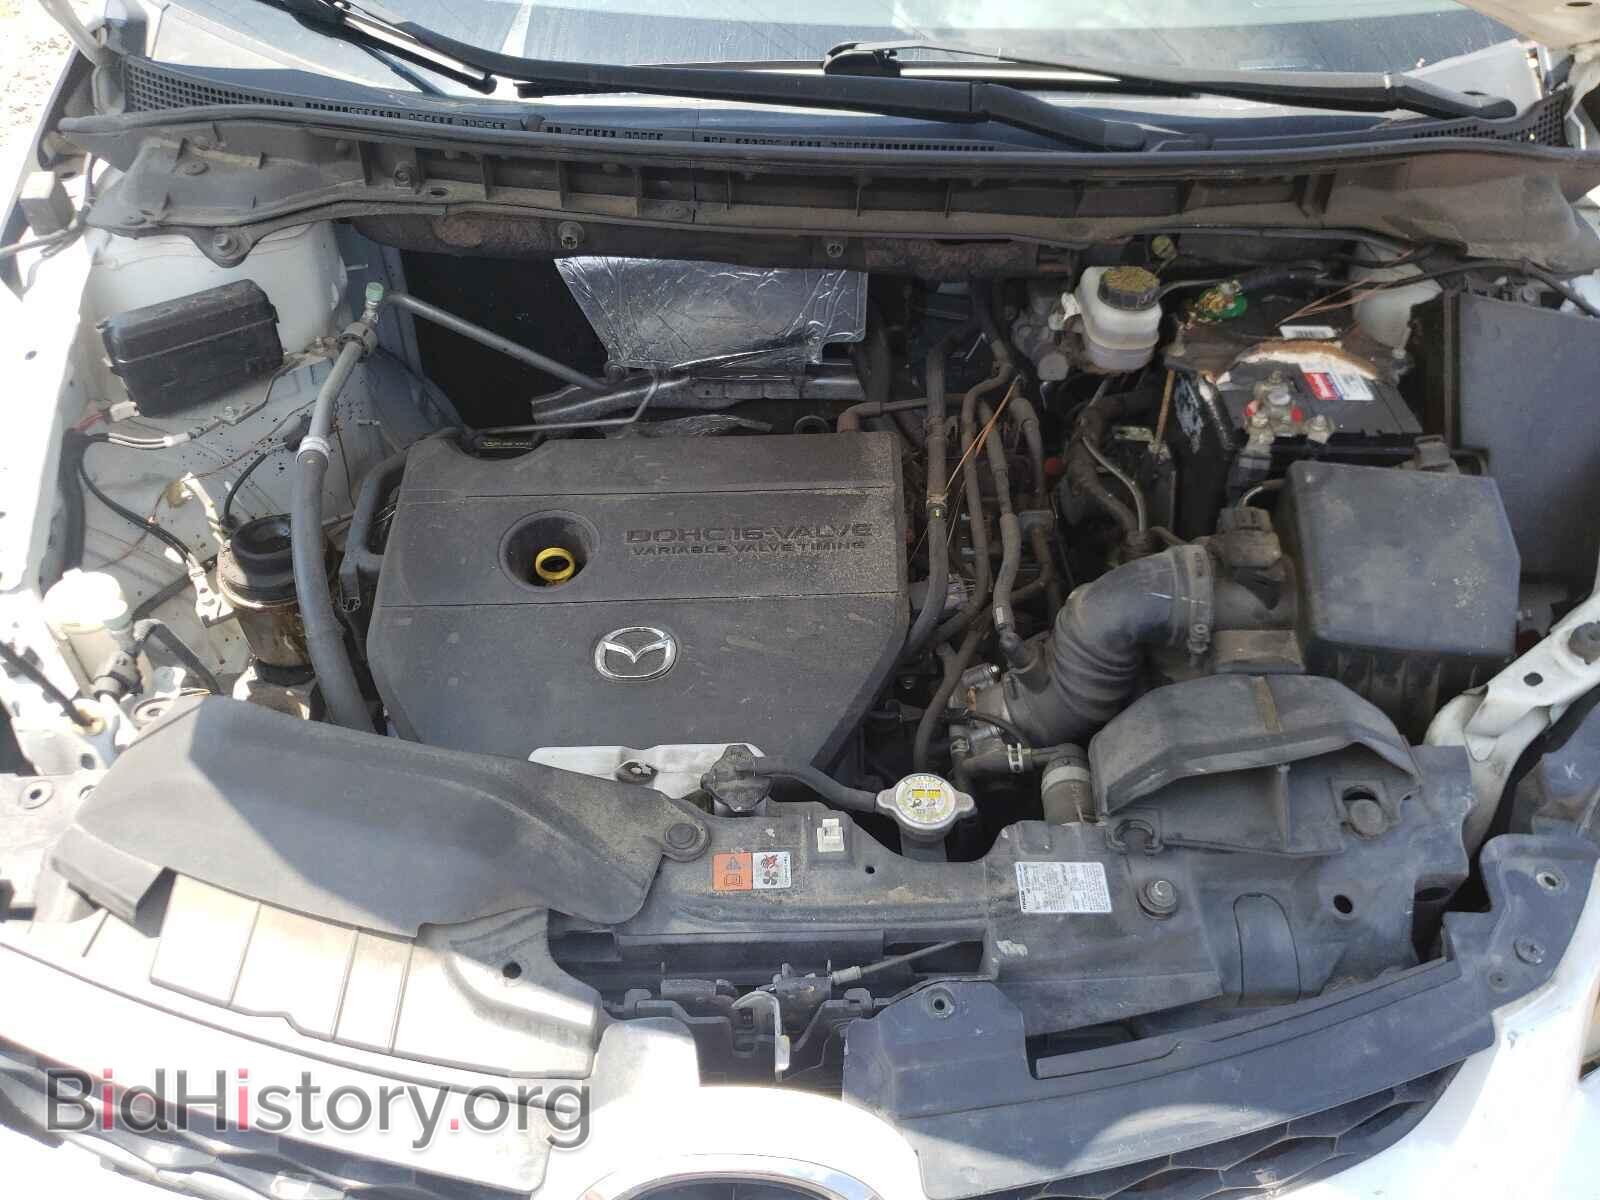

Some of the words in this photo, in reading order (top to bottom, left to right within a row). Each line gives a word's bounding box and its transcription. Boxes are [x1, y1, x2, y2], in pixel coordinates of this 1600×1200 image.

[626, 528, 725, 543] DOHC
[632, 543, 728, 556] VARIABLE
[734, 543, 793, 554] VALVE
[799, 541, 867, 553] TIMING
